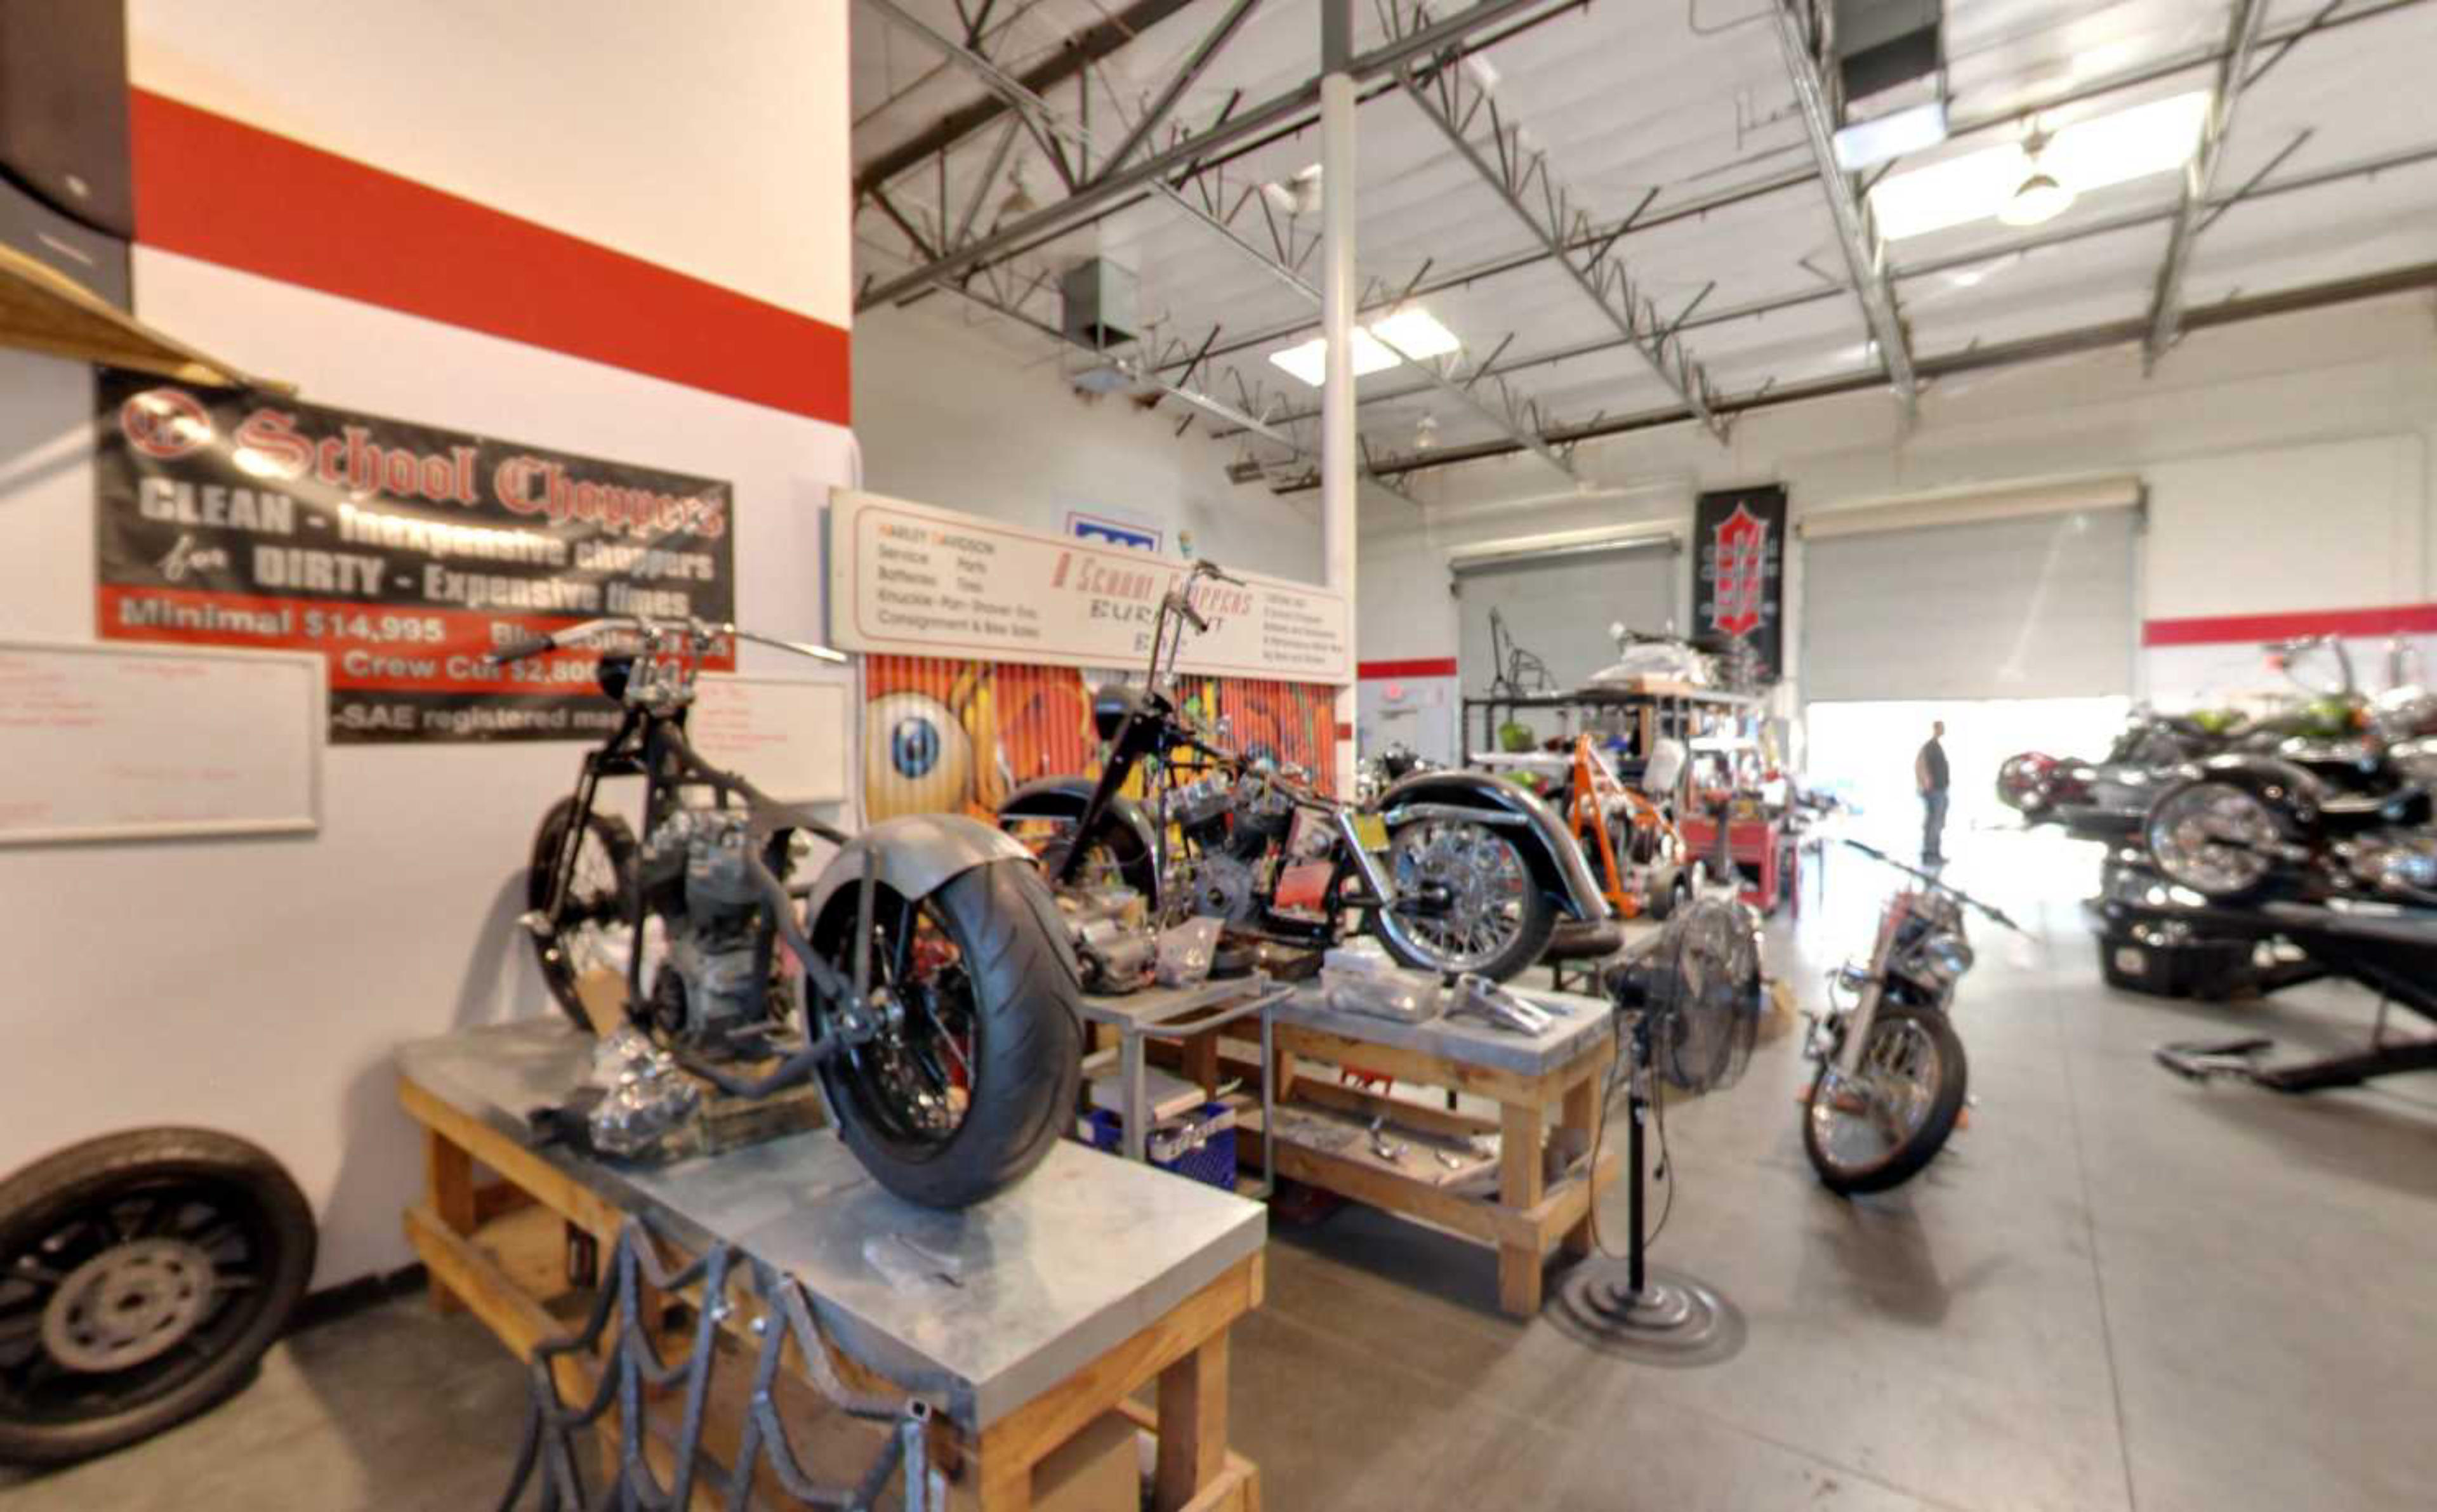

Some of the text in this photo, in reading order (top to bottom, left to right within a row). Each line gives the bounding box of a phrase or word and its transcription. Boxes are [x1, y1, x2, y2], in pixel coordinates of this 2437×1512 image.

[232, 408, 478, 506] School
[494, 454, 724, 539] Choppers
[139, 476, 293, 535] CLEAN
[157, 534, 227, 581] for
[254, 544, 385, 595] DIRTY
[423, 564, 602, 610] Expensive
[878, 544, 929, 565] Service
[119, 596, 444, 643] Minimal $14,995
[343, 650, 437, 678] Crew
[423, 706, 569, 734] registered
